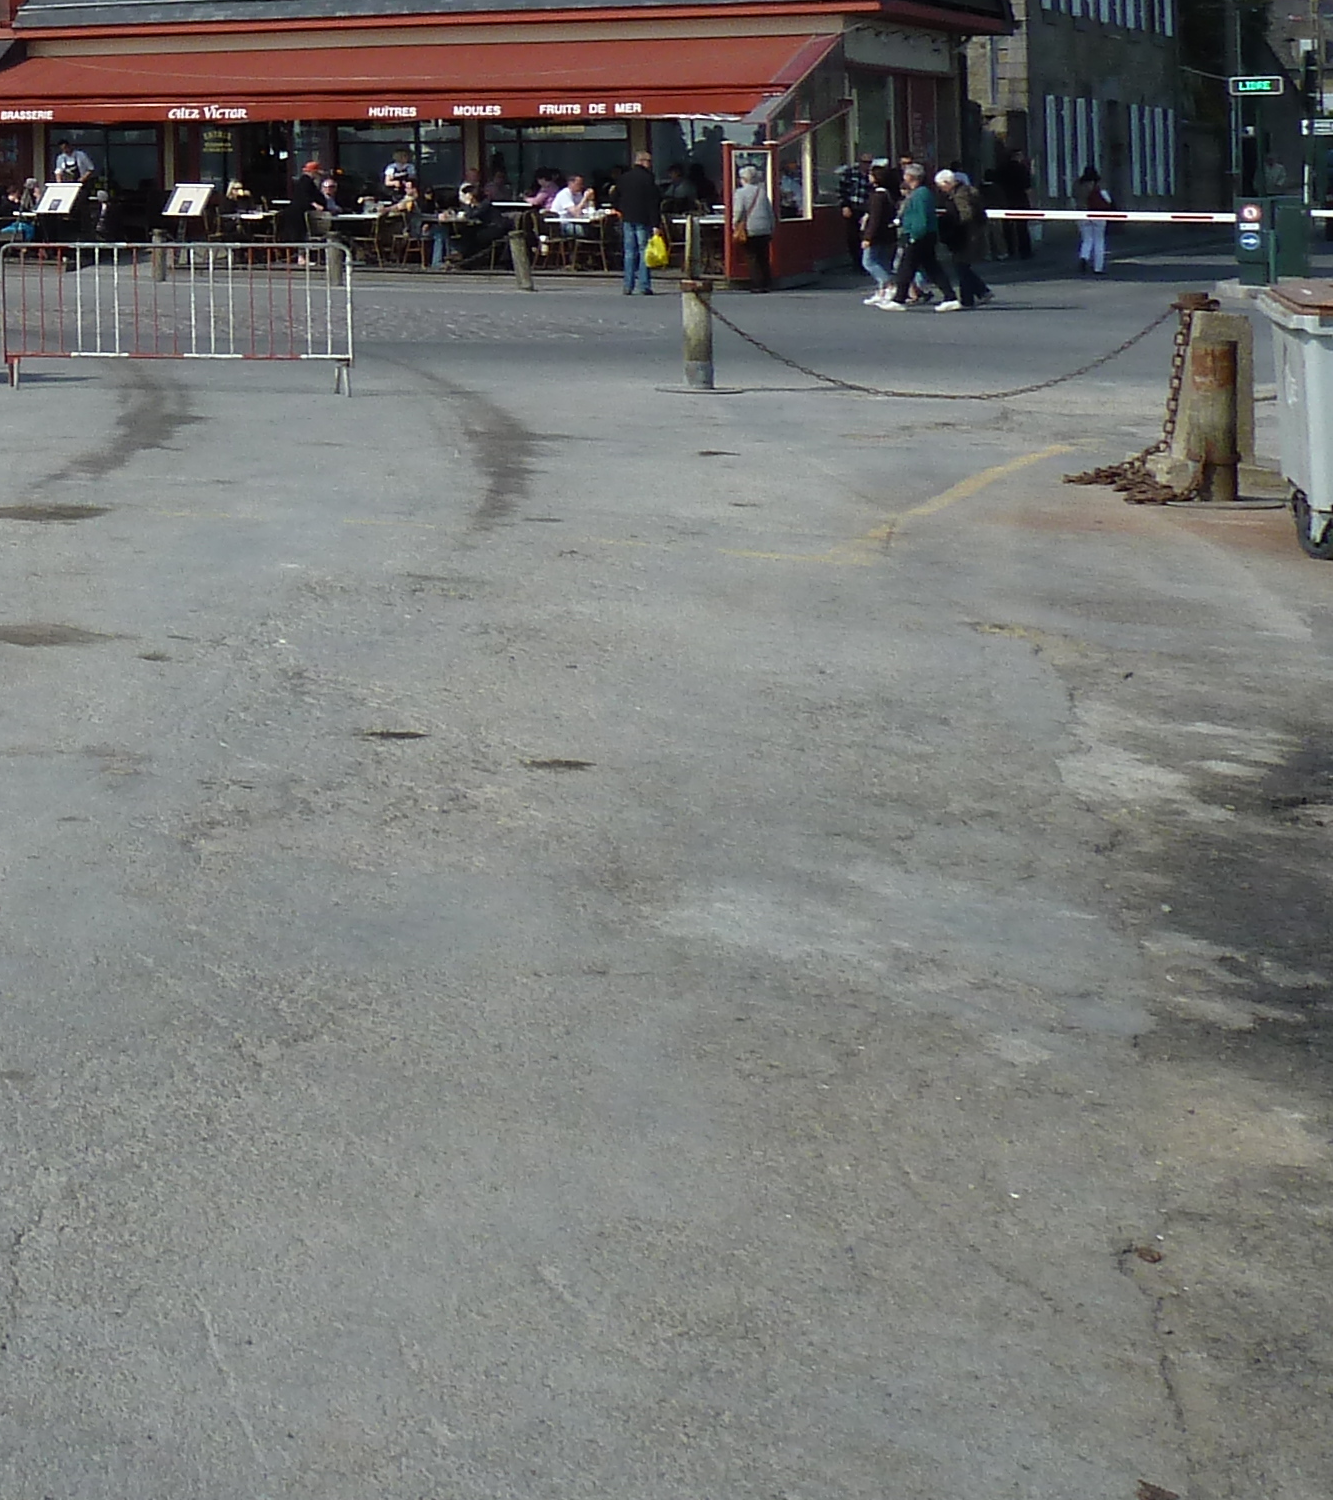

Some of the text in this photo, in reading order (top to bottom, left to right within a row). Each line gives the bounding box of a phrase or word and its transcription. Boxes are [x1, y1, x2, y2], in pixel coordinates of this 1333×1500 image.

[1238, 80, 1271, 91] LIBRE
[368, 104, 417, 117] HUÎTRES
[453, 105, 501, 116] MOULES
[539, 102, 642, 115] FRUITS DE MER
[0, 110, 54, 121] BRASSERIE
